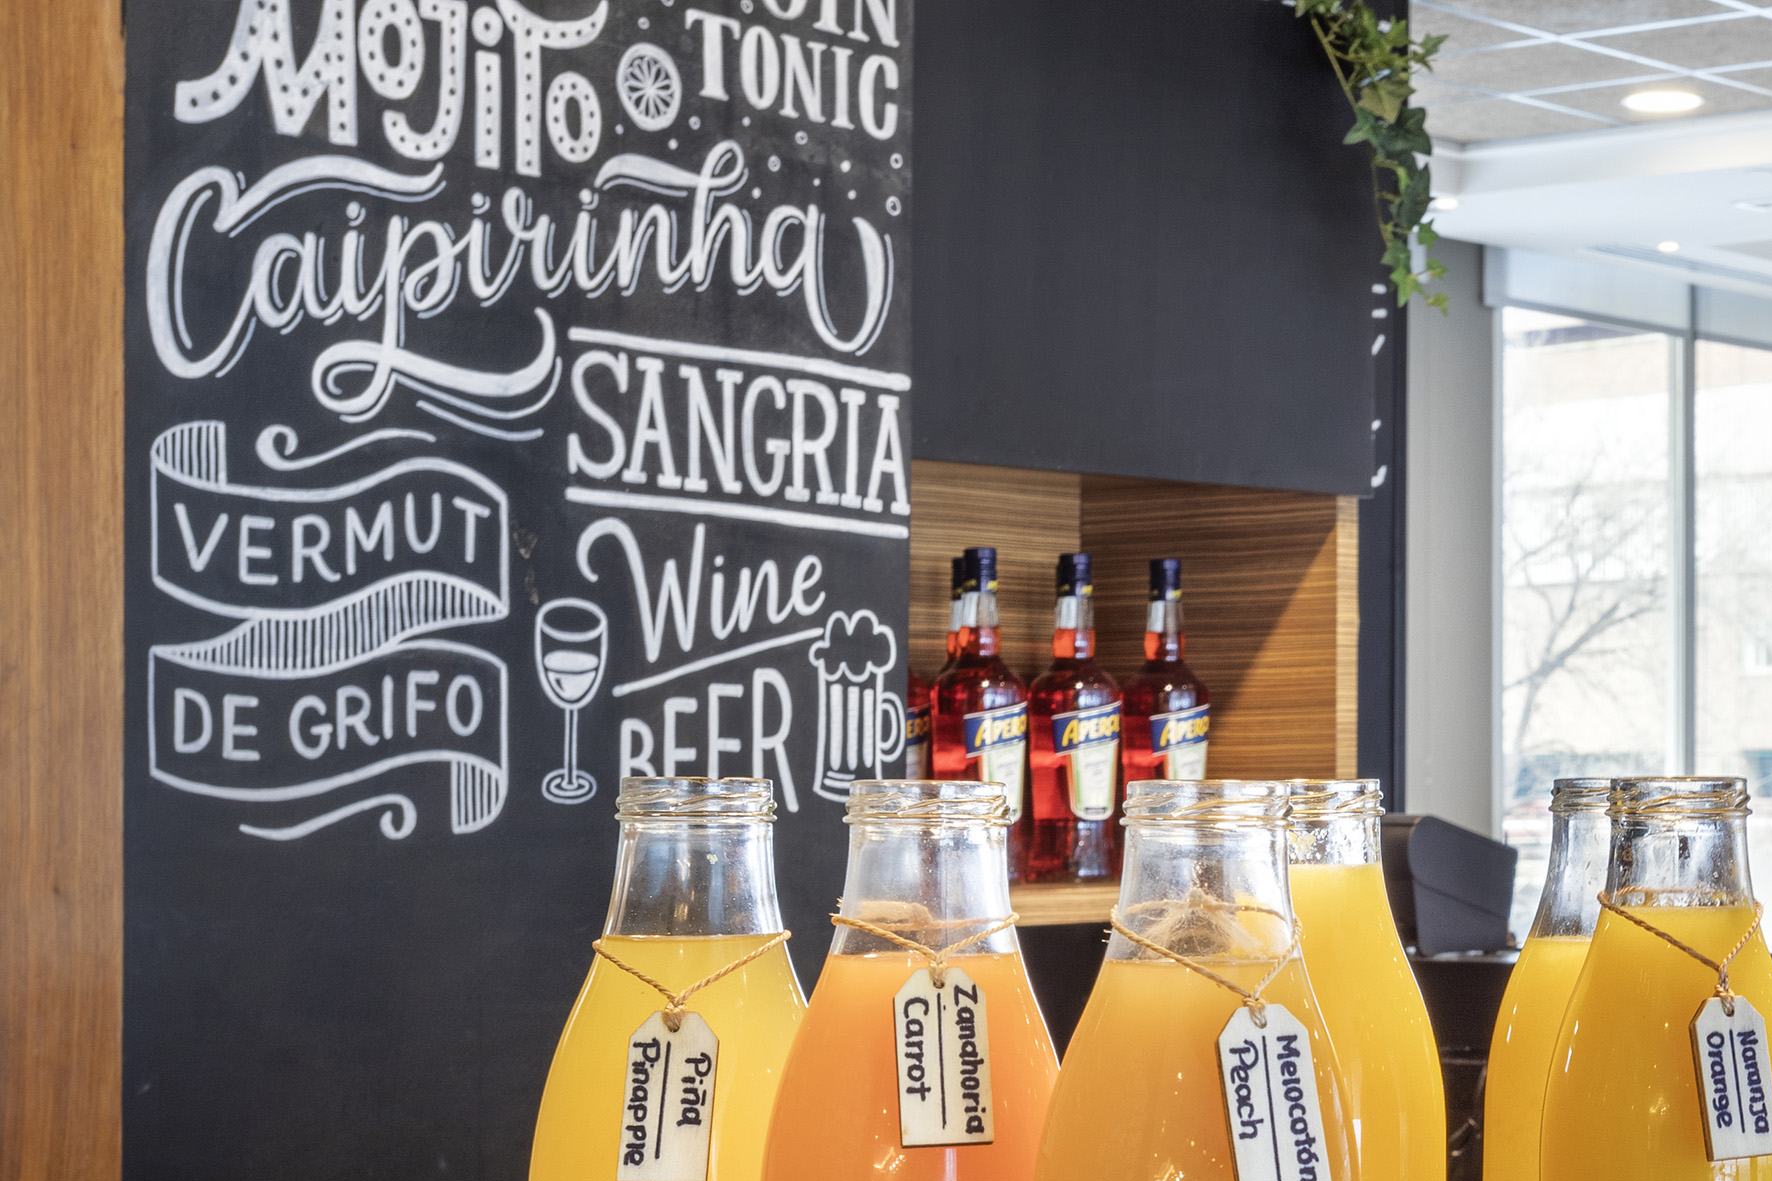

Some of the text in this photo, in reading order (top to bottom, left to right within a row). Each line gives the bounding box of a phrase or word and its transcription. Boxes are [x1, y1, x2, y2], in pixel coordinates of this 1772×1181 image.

[685, 9, 899, 140] TONIC
[146, 140, 894, 420] Caipirinha
[567, 350, 911, 516] SANGRIA
[173, 492, 491, 586] VERMUT
[577, 517, 826, 663] Wine
[174, 671, 483, 762] DE GRIFO
[623, 1037, 661, 1167] Pinapple
[677, 1052, 712, 1127] Piña
[903, 997, 932, 1102] Carrot
[954, 984, 987, 1135] Zanahoria
[1229, 1039, 1264, 1140] Peach
[1706, 1030, 1733, 1129] Orange
